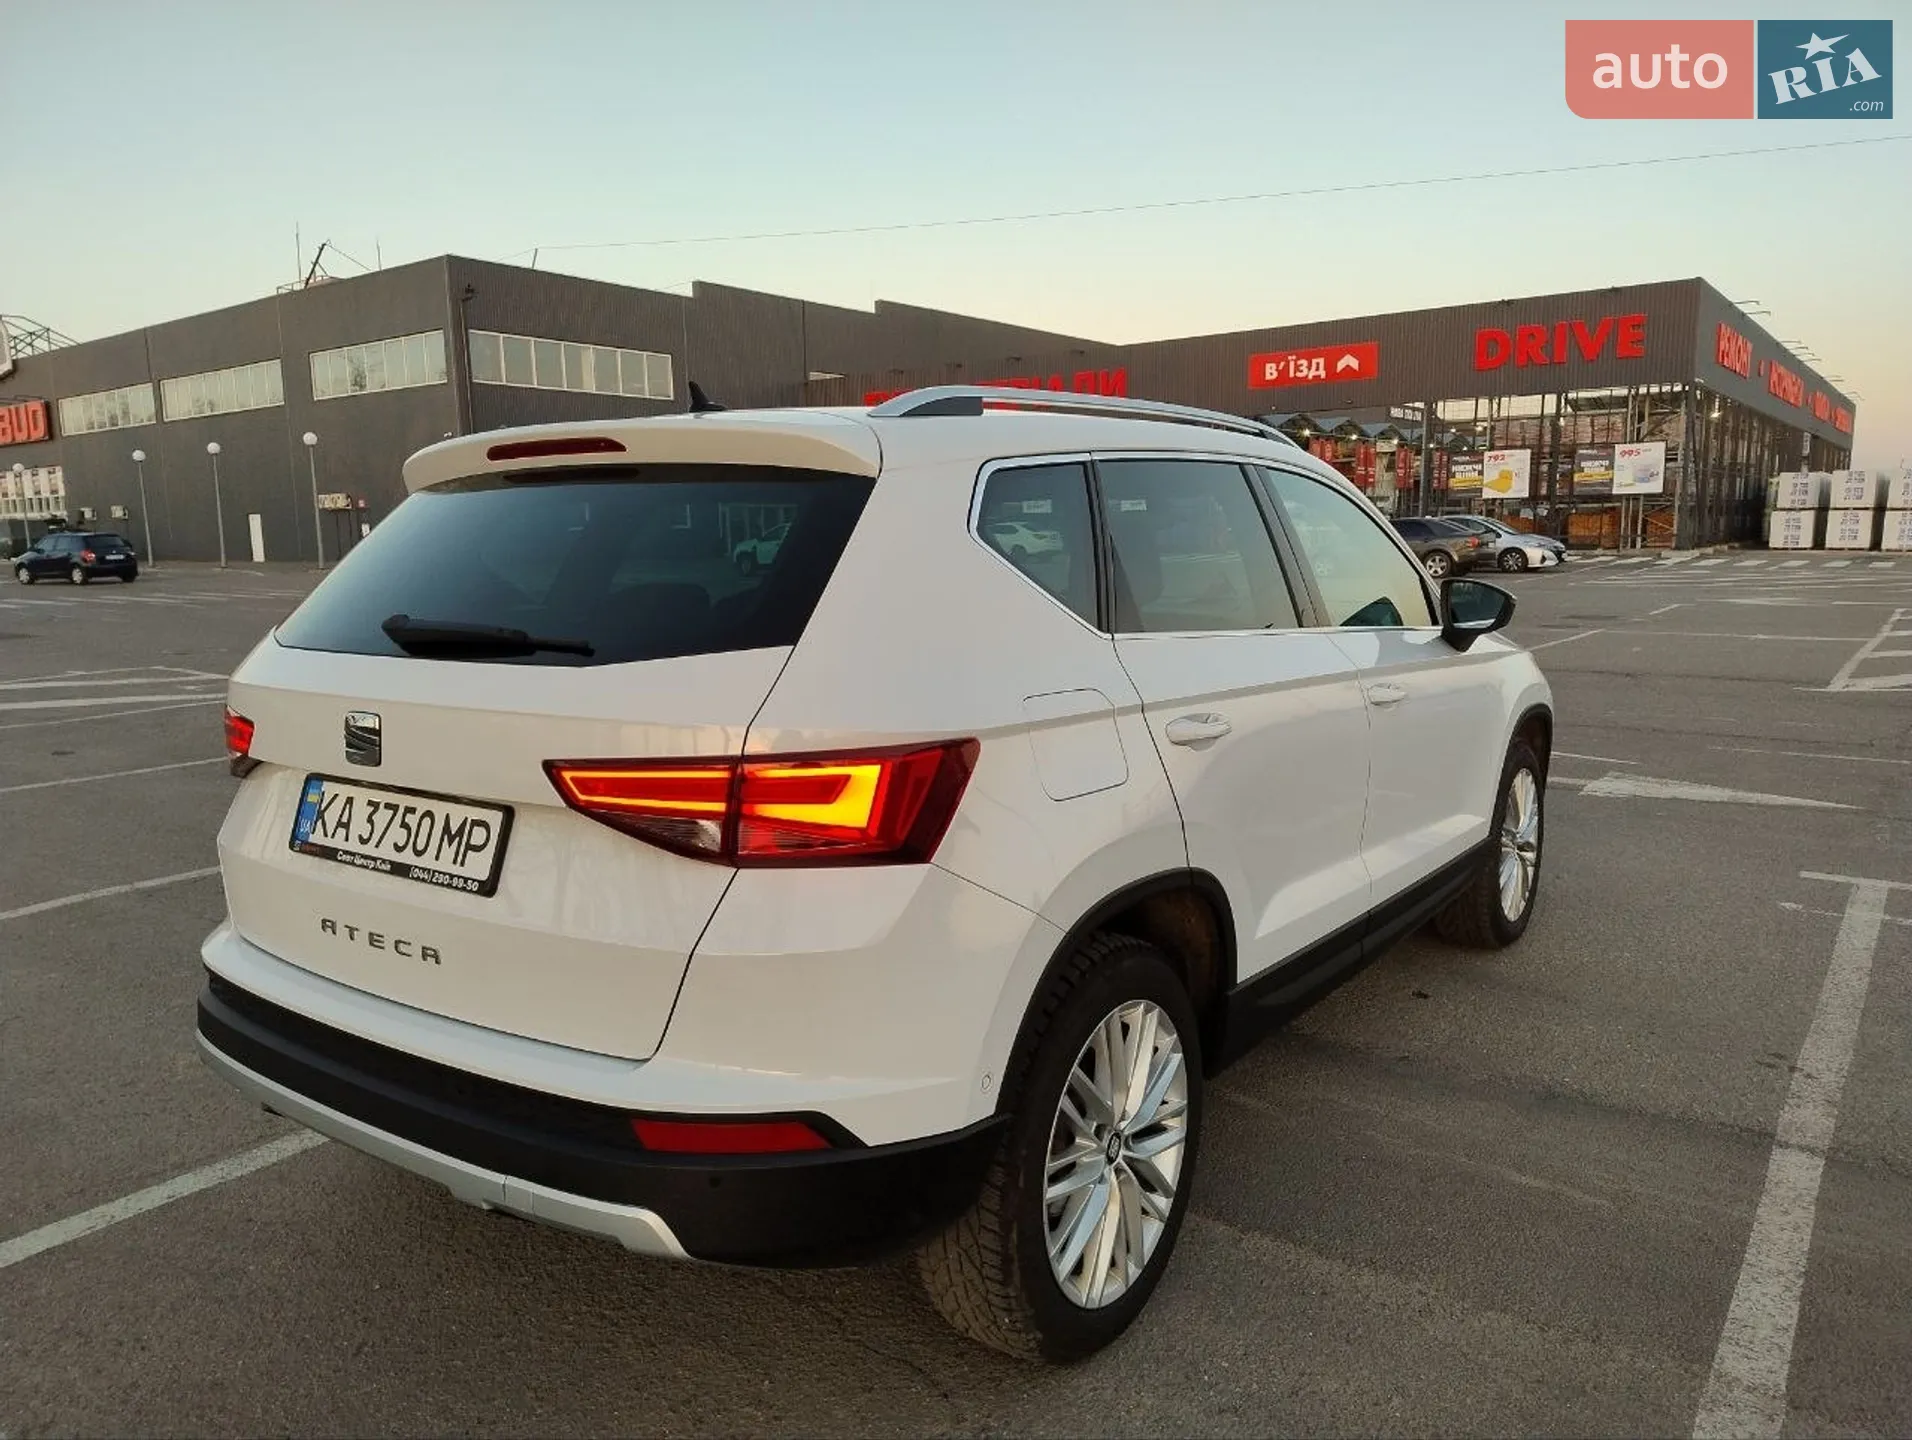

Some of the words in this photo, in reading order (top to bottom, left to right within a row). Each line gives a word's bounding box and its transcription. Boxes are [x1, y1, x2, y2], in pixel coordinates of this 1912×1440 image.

[1473, 313, 1648, 372] DRIVE
[312, 790, 354, 842] KA
[358, 799, 435, 858] 3750
[435, 812, 492, 868] MP
[321, 917, 442, 965] ATECA
